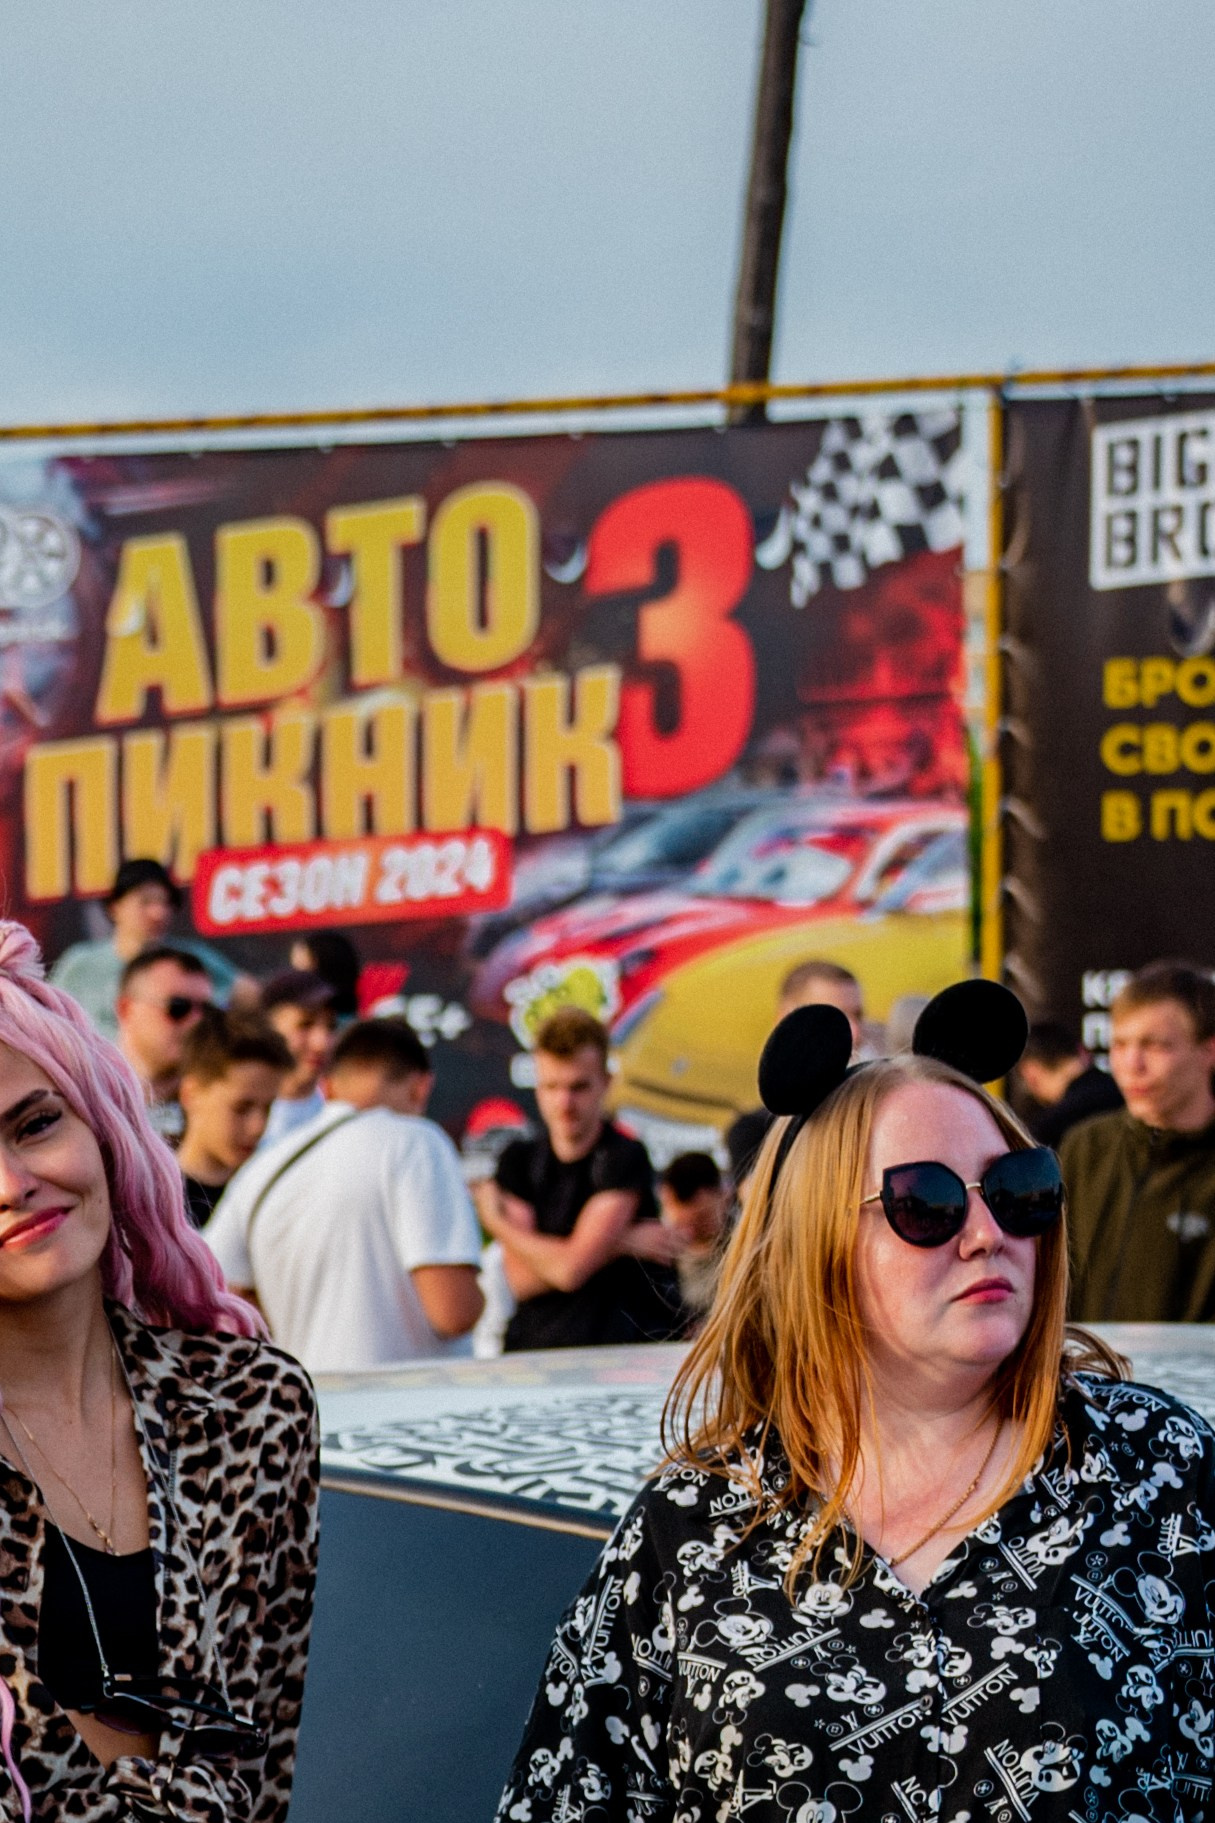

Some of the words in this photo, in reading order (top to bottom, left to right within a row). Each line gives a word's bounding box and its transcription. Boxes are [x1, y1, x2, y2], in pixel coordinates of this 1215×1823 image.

[1105, 427, 1209, 497] BIG
[95, 481, 542, 725] АВТО
[587, 474, 756, 798] 3
[24, 662, 622, 903] ПИКНИК
[208, 852, 369, 926] СЕЗОН
[373, 836, 493, 906] 2024
[1007, 1535, 1046, 1580] VUITTO
[590, 1578, 625, 1662] VUITTON
[744, 1626, 824, 1668] VUITTON
[941, 1667, 1019, 1728] VUITTON
[992, 1737, 1041, 1808] VUITTON
